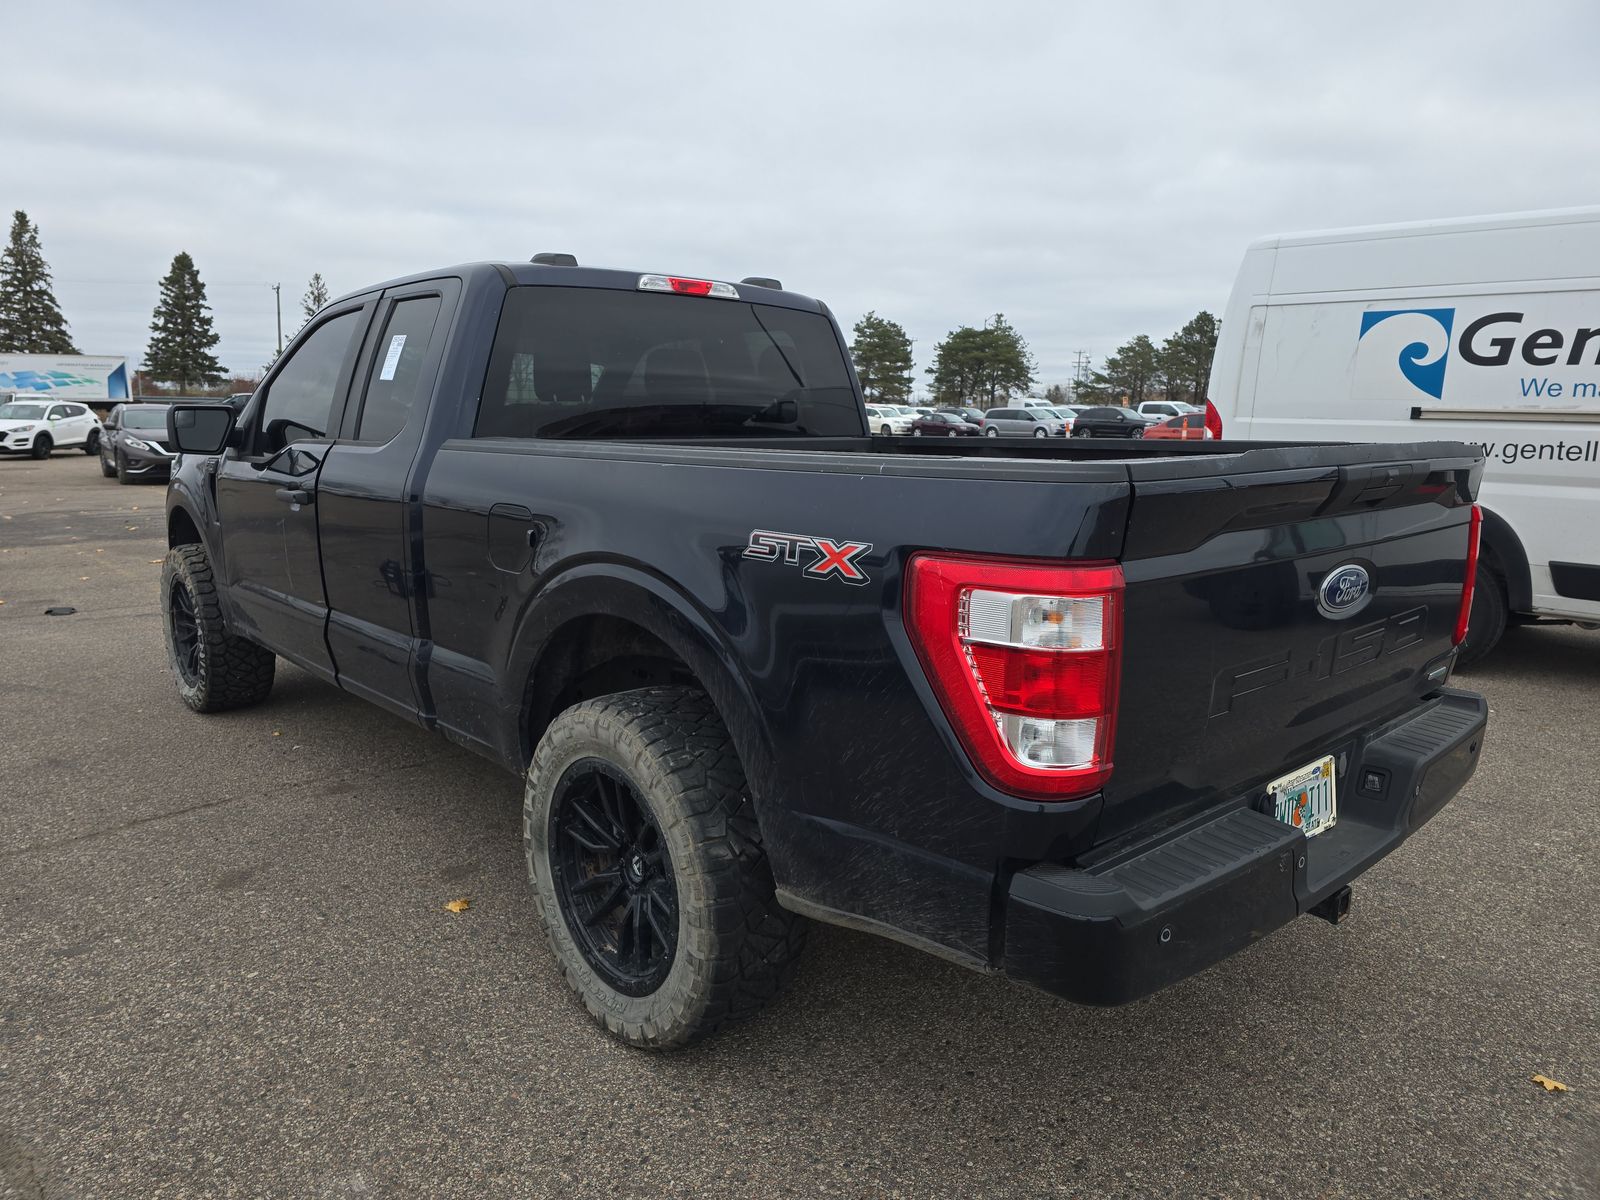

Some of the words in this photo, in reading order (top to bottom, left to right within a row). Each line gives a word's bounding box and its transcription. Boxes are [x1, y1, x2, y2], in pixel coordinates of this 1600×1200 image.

[1458, 311, 1600, 367] Gen
[1520, 377, 1563, 398] We
[1572, 382, 1600, 398] m
[741, 529, 874, 587] STX
